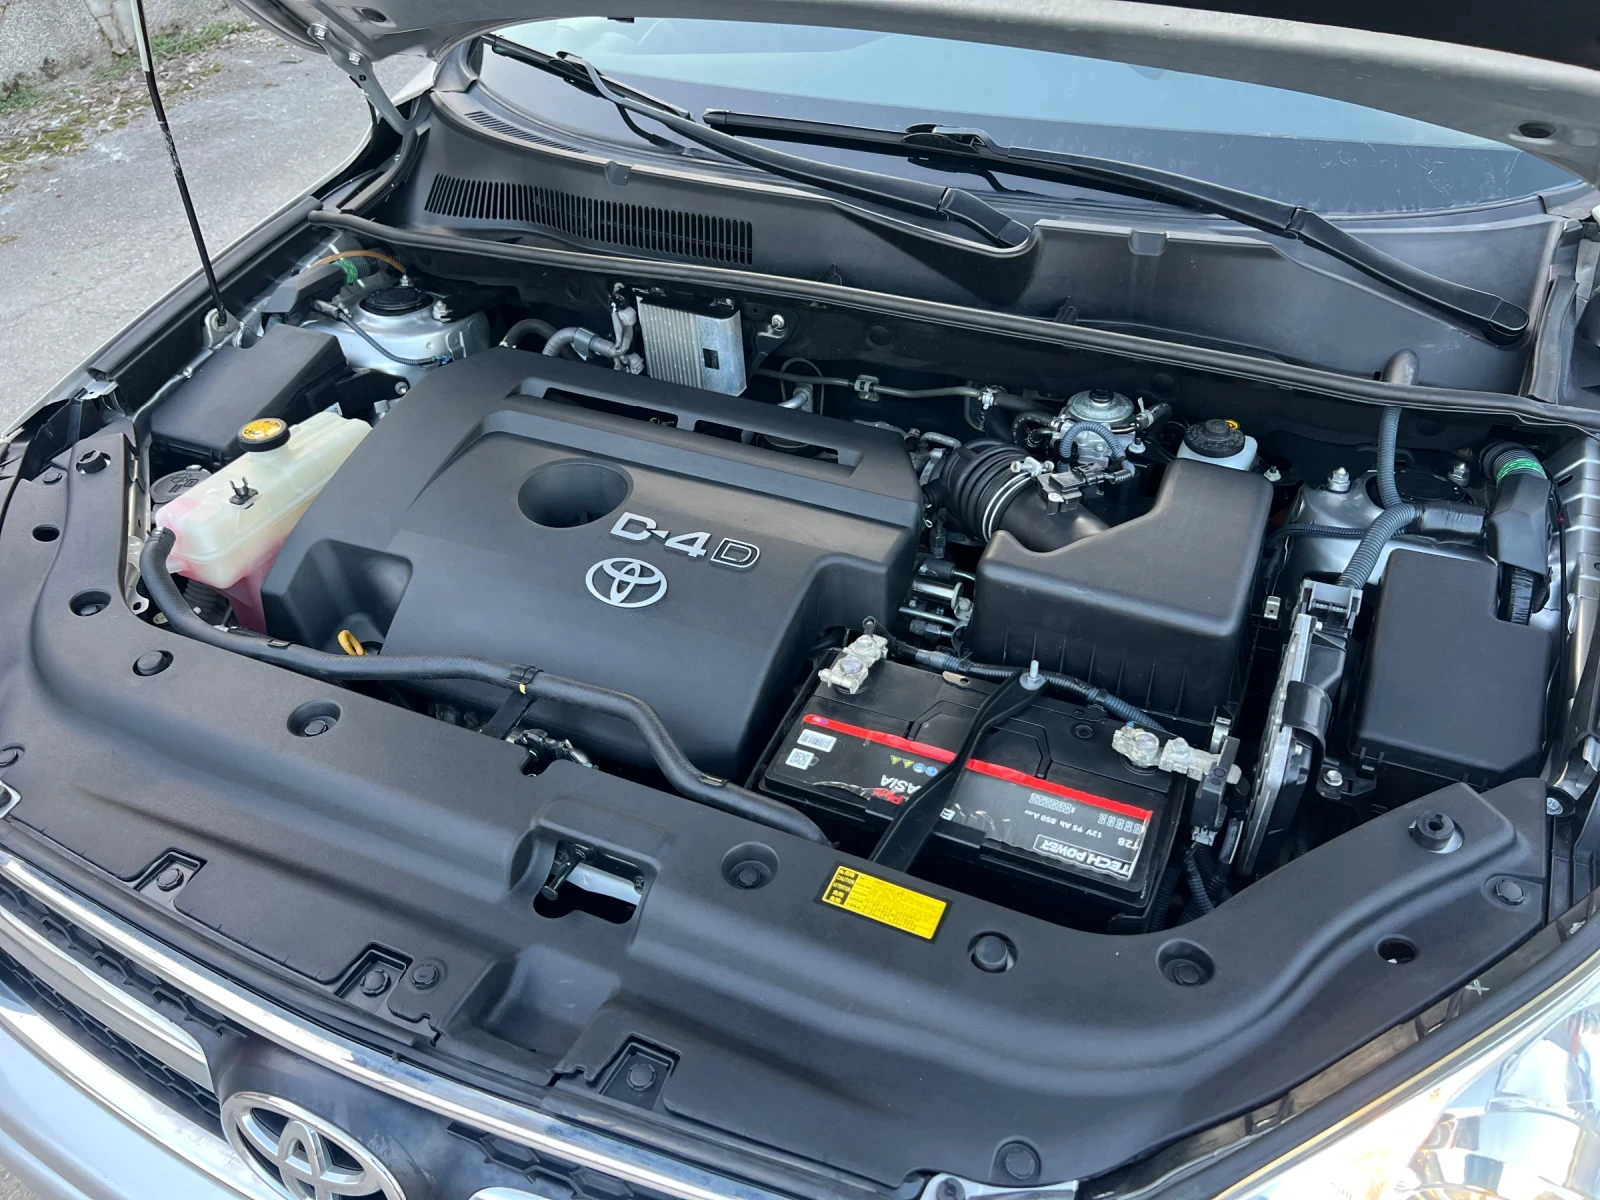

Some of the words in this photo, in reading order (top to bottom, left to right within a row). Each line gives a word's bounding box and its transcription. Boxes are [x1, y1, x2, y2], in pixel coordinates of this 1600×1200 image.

[880, 774, 921, 794] ASIA
[1040, 815, 1057, 825] 850
[1059, 820, 1072, 829] Ah
[1072, 824, 1083, 833] 95
[1085, 829, 1102, 839] 12V
[1041, 839, 1087, 862] POWER
[1086, 853, 1131, 875] TECH
